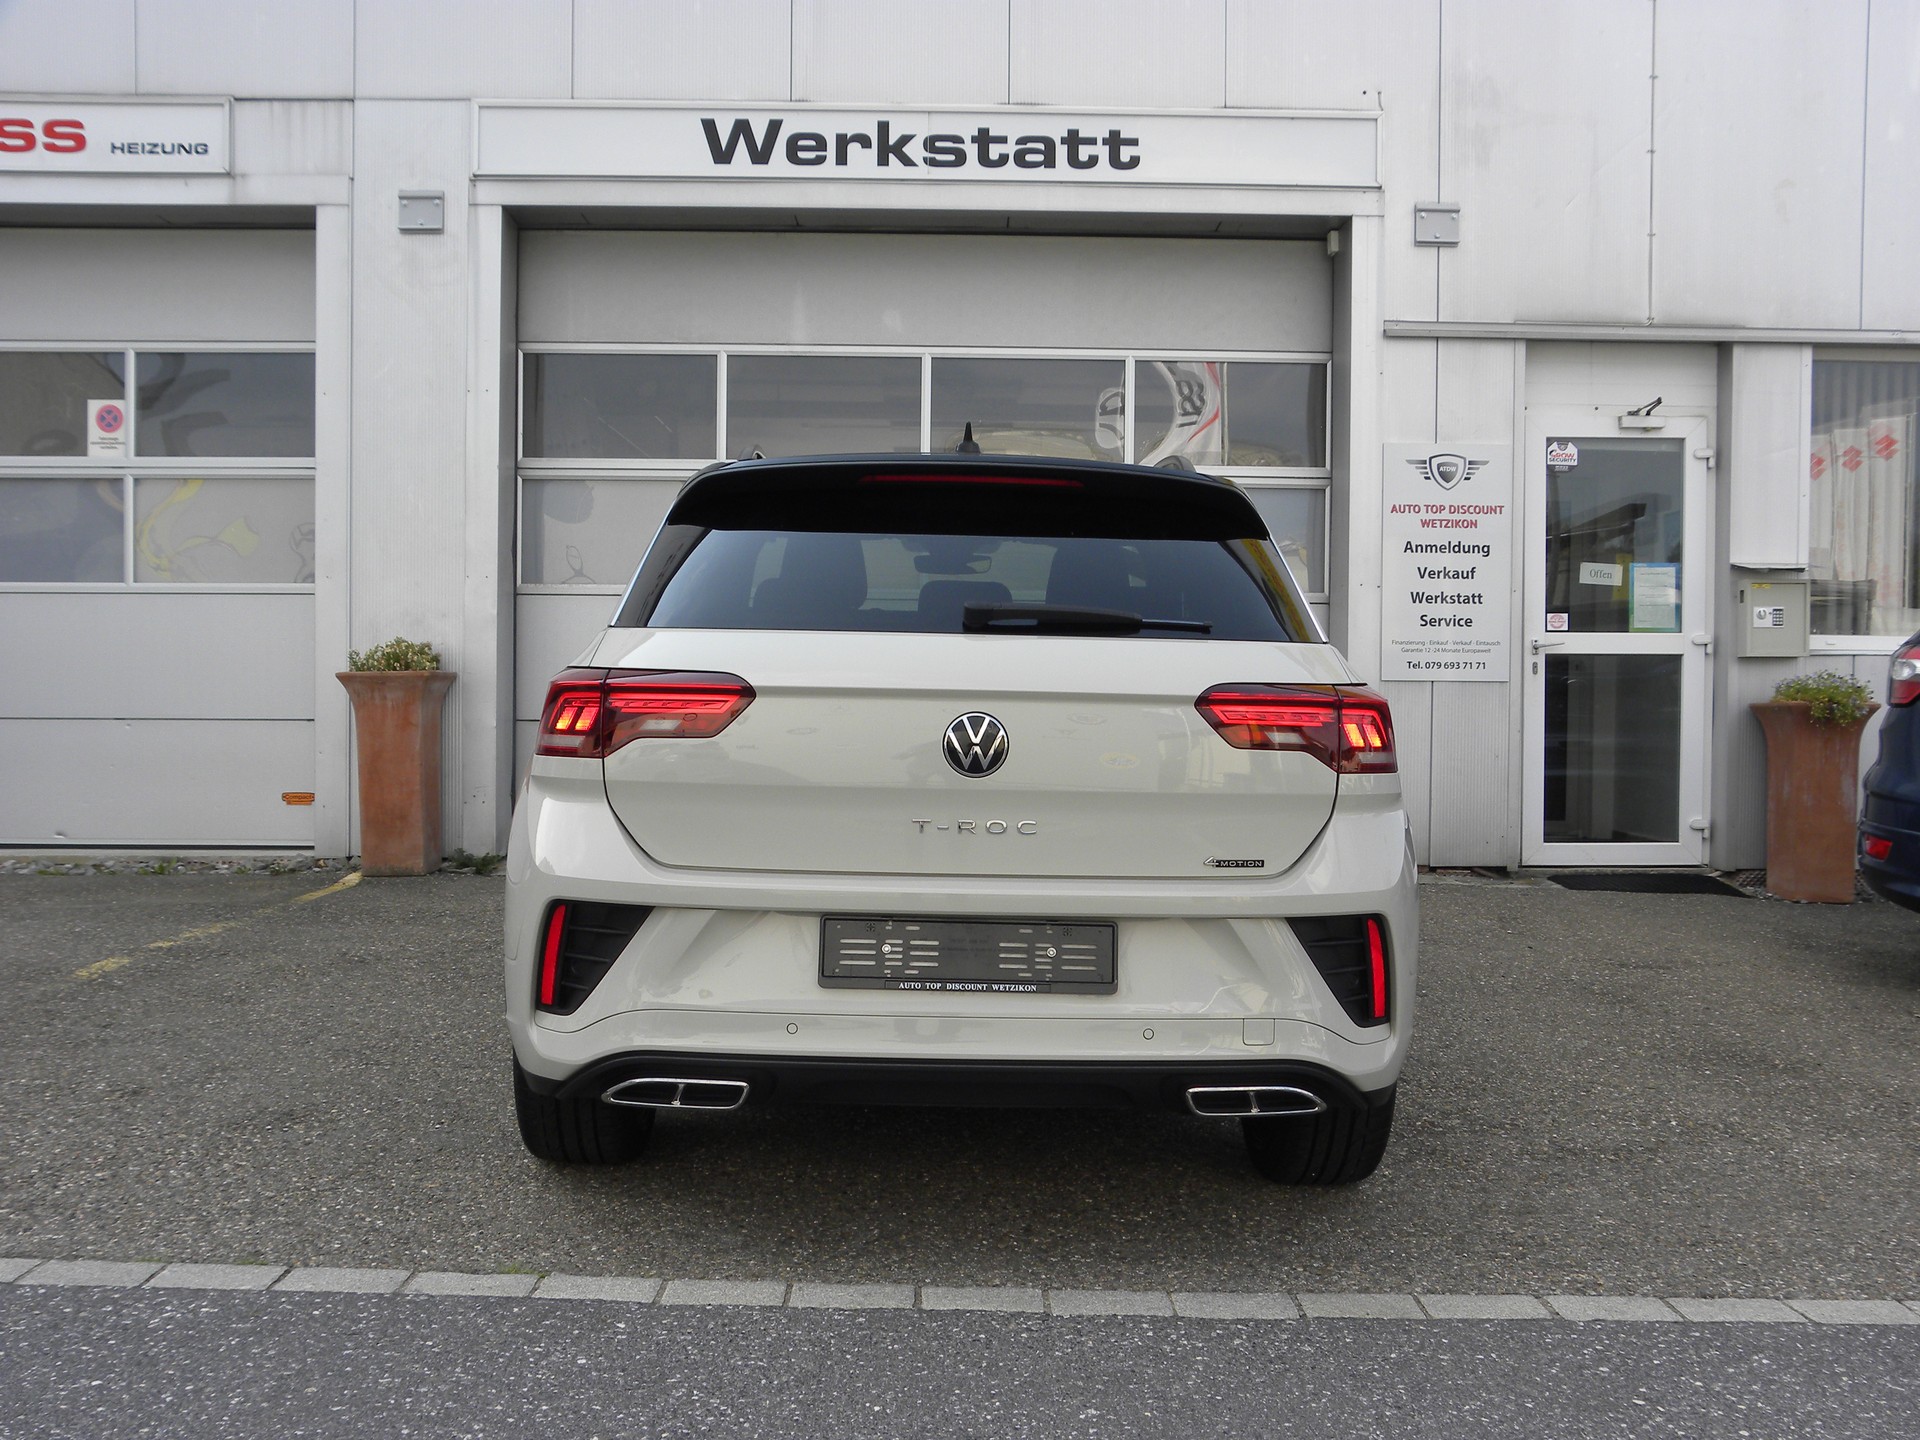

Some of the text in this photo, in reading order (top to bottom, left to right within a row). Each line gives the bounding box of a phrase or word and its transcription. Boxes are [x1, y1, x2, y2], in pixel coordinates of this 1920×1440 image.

[110, 142, 209, 155] HEIZUNG
[700, 117, 1141, 170] Werkstatt
[1390, 504, 1505, 515] AUTO TOP DISCOUNT
[1420, 518, 1478, 529] WETZIKON
[1403, 541, 1491, 557] Anmeldung
[1417, 566, 1477, 580] Verkauf
[1589, 569, 1613, 579] Offen
[1410, 591, 1483, 605] Werkstatt
[1419, 614, 1473, 627] Service
[1406, 661, 1487, 670] Tel. 079 693 71 71
[944, 713, 1008, 775] VW
[912, 818, 1038, 834] T-ROC
[1203, 856, 1263, 867] 4MOTION
[898, 982, 1037, 992] AUTO TOP DISCOUNT WETZIKON
